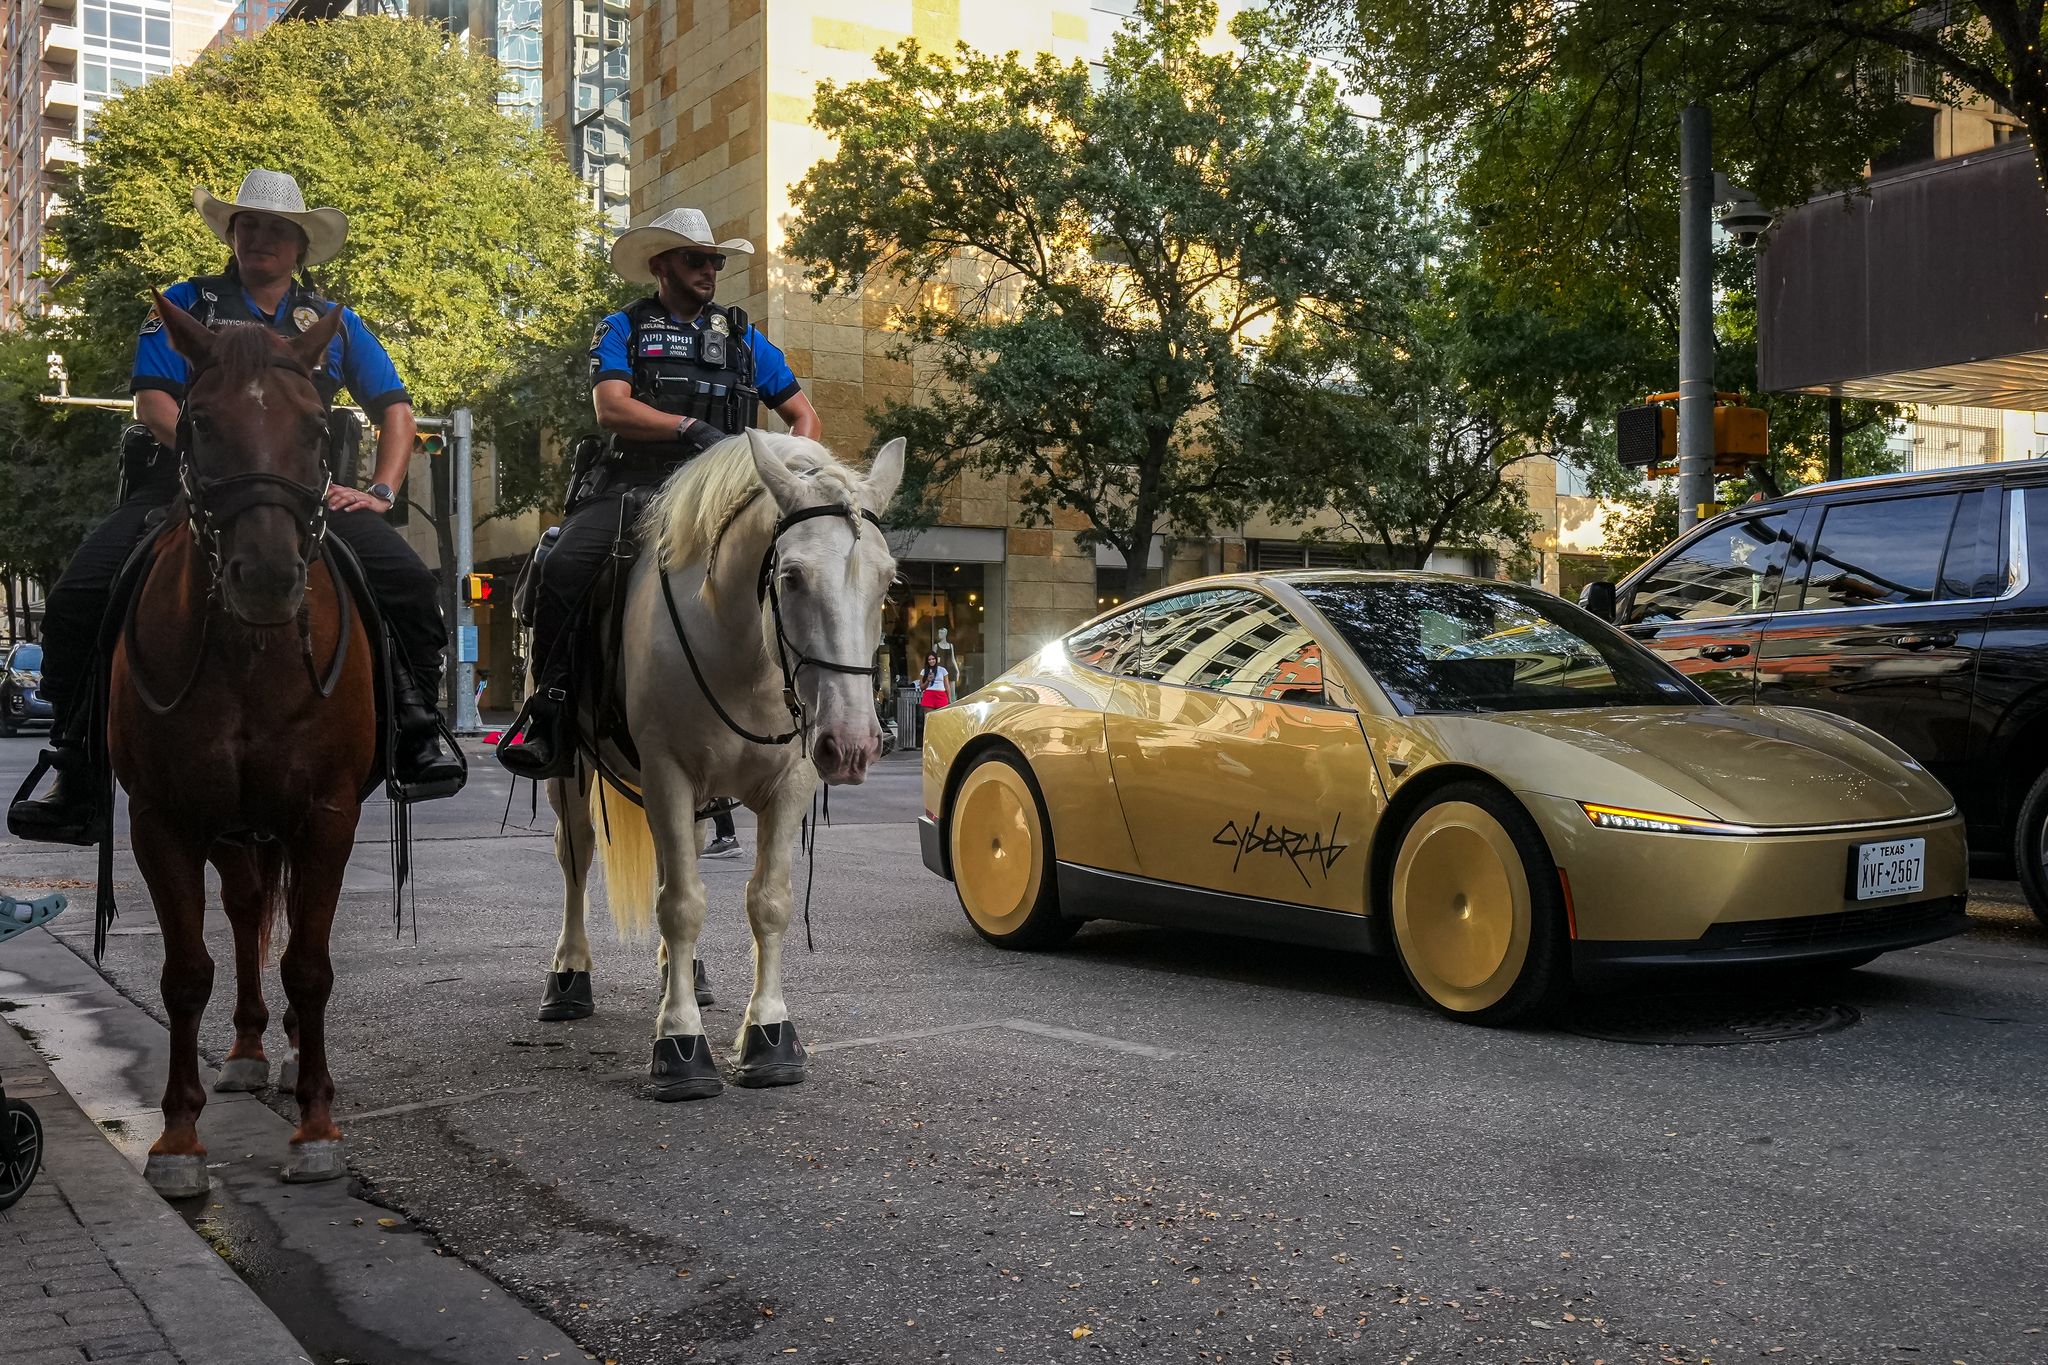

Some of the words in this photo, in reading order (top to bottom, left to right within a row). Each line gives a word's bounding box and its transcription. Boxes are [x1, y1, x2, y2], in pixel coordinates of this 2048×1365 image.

[641, 333, 662, 343] APD
[666, 334, 693, 345] MP81
[1880, 844, 1905, 857] TEXAS
[1862, 862, 1884, 889] XVF
[1890, 857, 1920, 885] 2567
